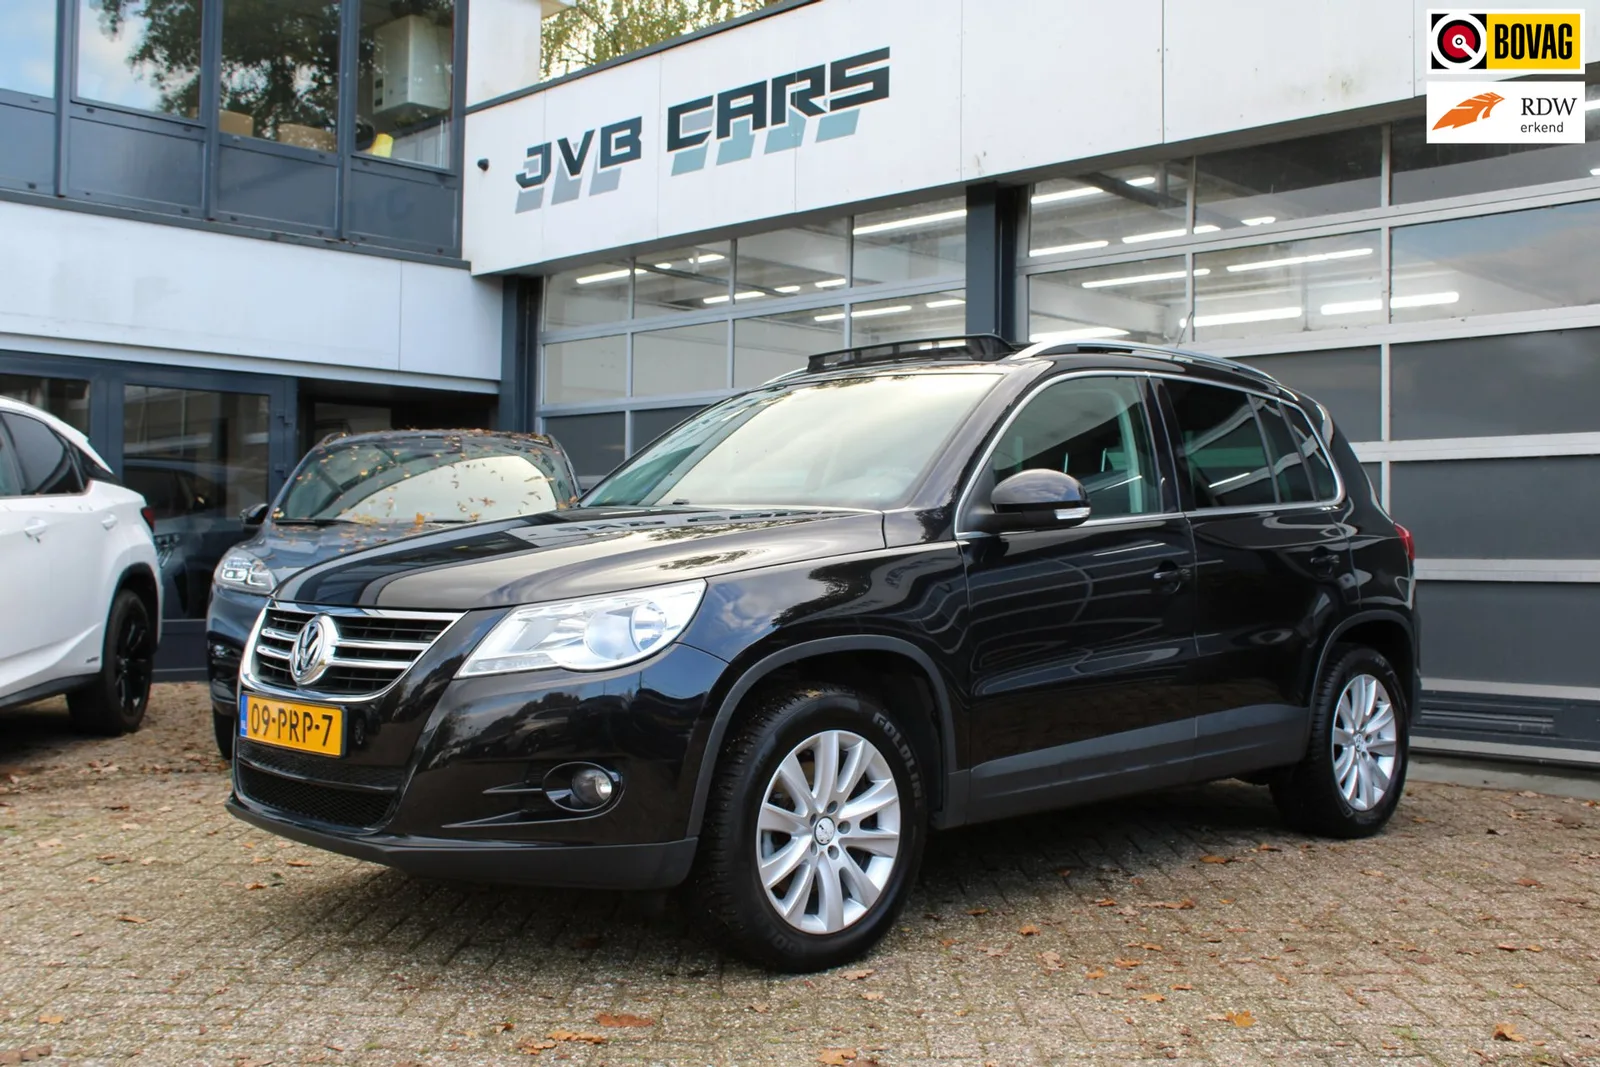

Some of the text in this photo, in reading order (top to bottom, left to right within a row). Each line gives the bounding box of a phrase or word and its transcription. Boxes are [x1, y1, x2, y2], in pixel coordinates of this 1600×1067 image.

[515, 46, 890, 189] JVB CARS
[251, 703, 334, 747] 09-PRP-7
